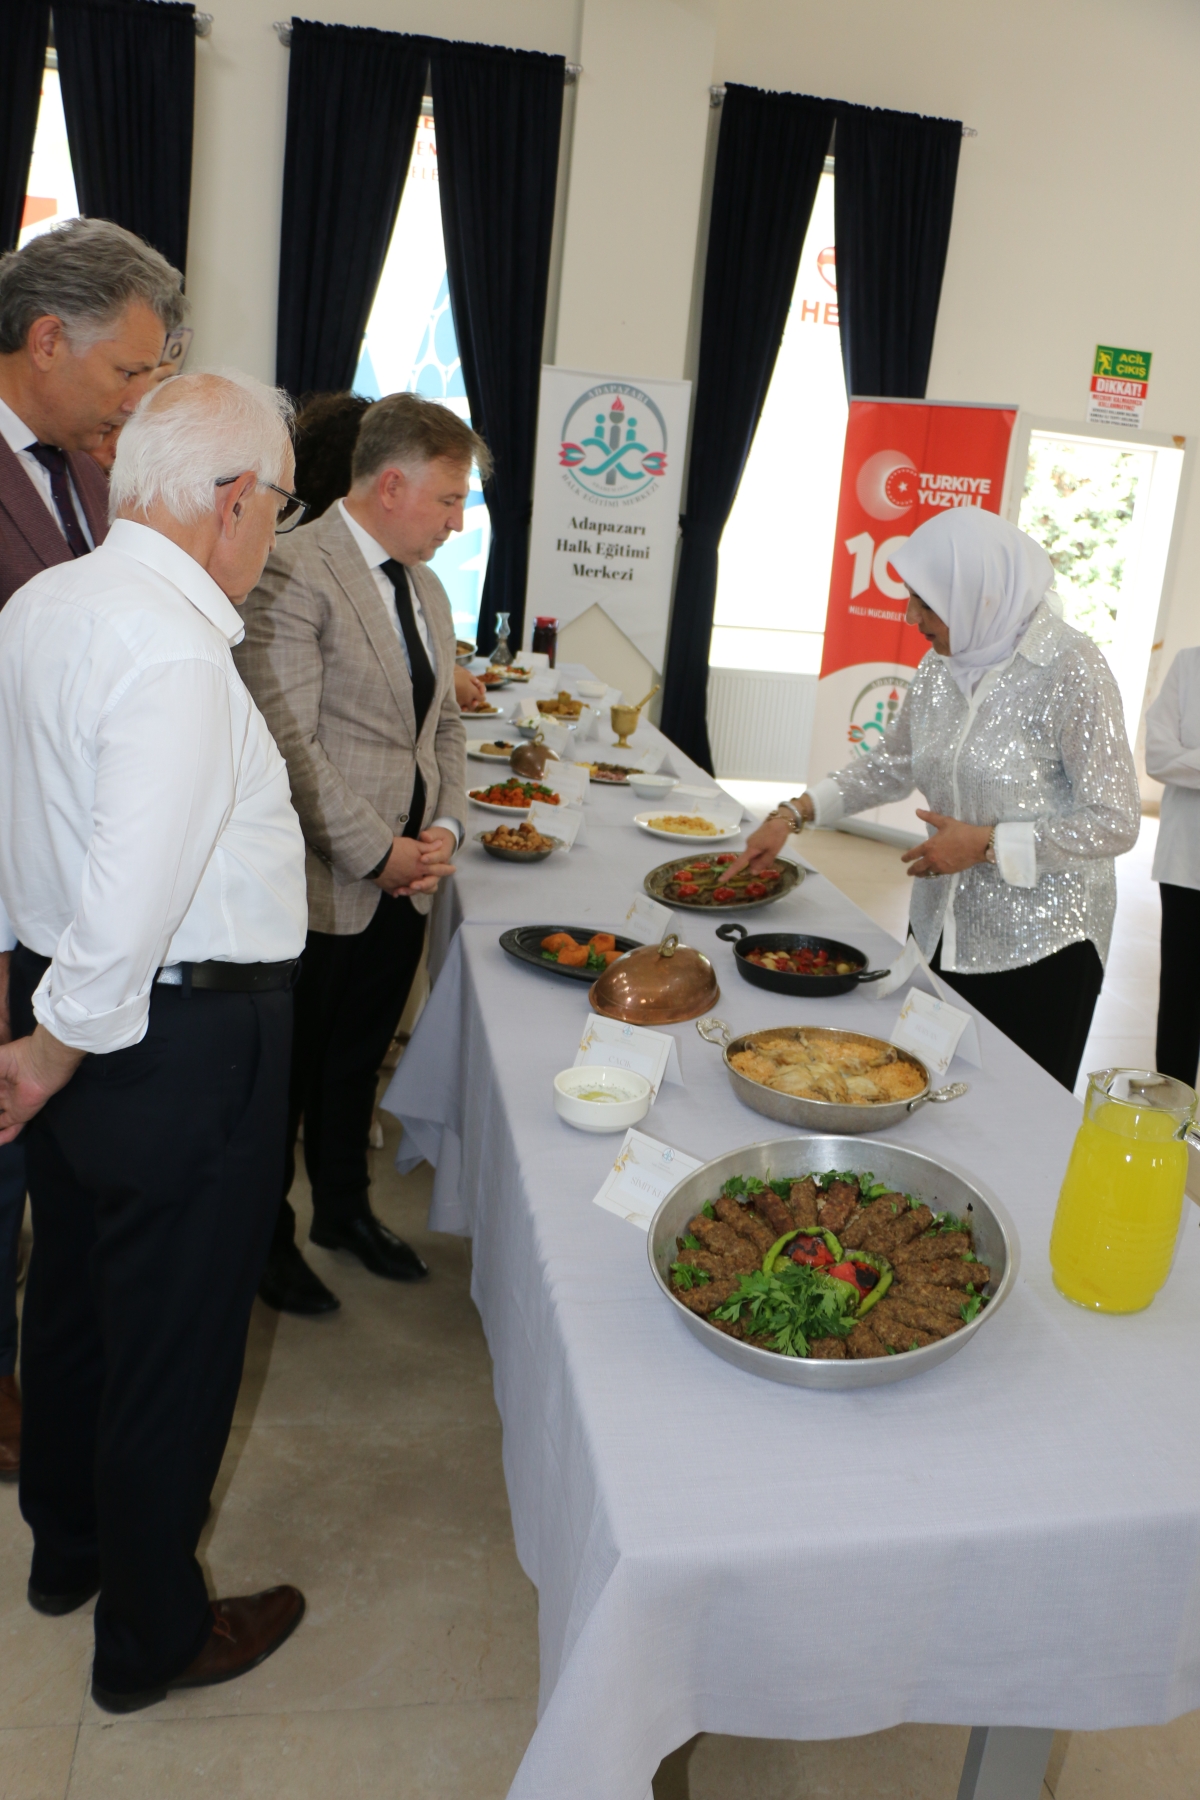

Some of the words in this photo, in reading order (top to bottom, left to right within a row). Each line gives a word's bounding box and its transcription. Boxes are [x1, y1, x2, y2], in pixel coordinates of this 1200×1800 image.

[1120, 353, 1146, 366] ACİL
[1116, 364, 1147, 378] ÇIKIŞ
[587, 384, 650, 404] ADAPAZARI
[1096, 378, 1143, 397] DİKKAT!
[561, 473, 581, 496] HALK
[583, 493, 619, 508] EĞİTİMİ
[622, 482, 660, 506] MERKEZİ
[919, 473, 992, 495] TÜRKİYE
[567, 516, 646, 536] Adapazarı
[556, 538, 592, 555] Halk
[596, 542, 650, 560] Eğitimi
[571, 563, 634, 581] Merkezi
